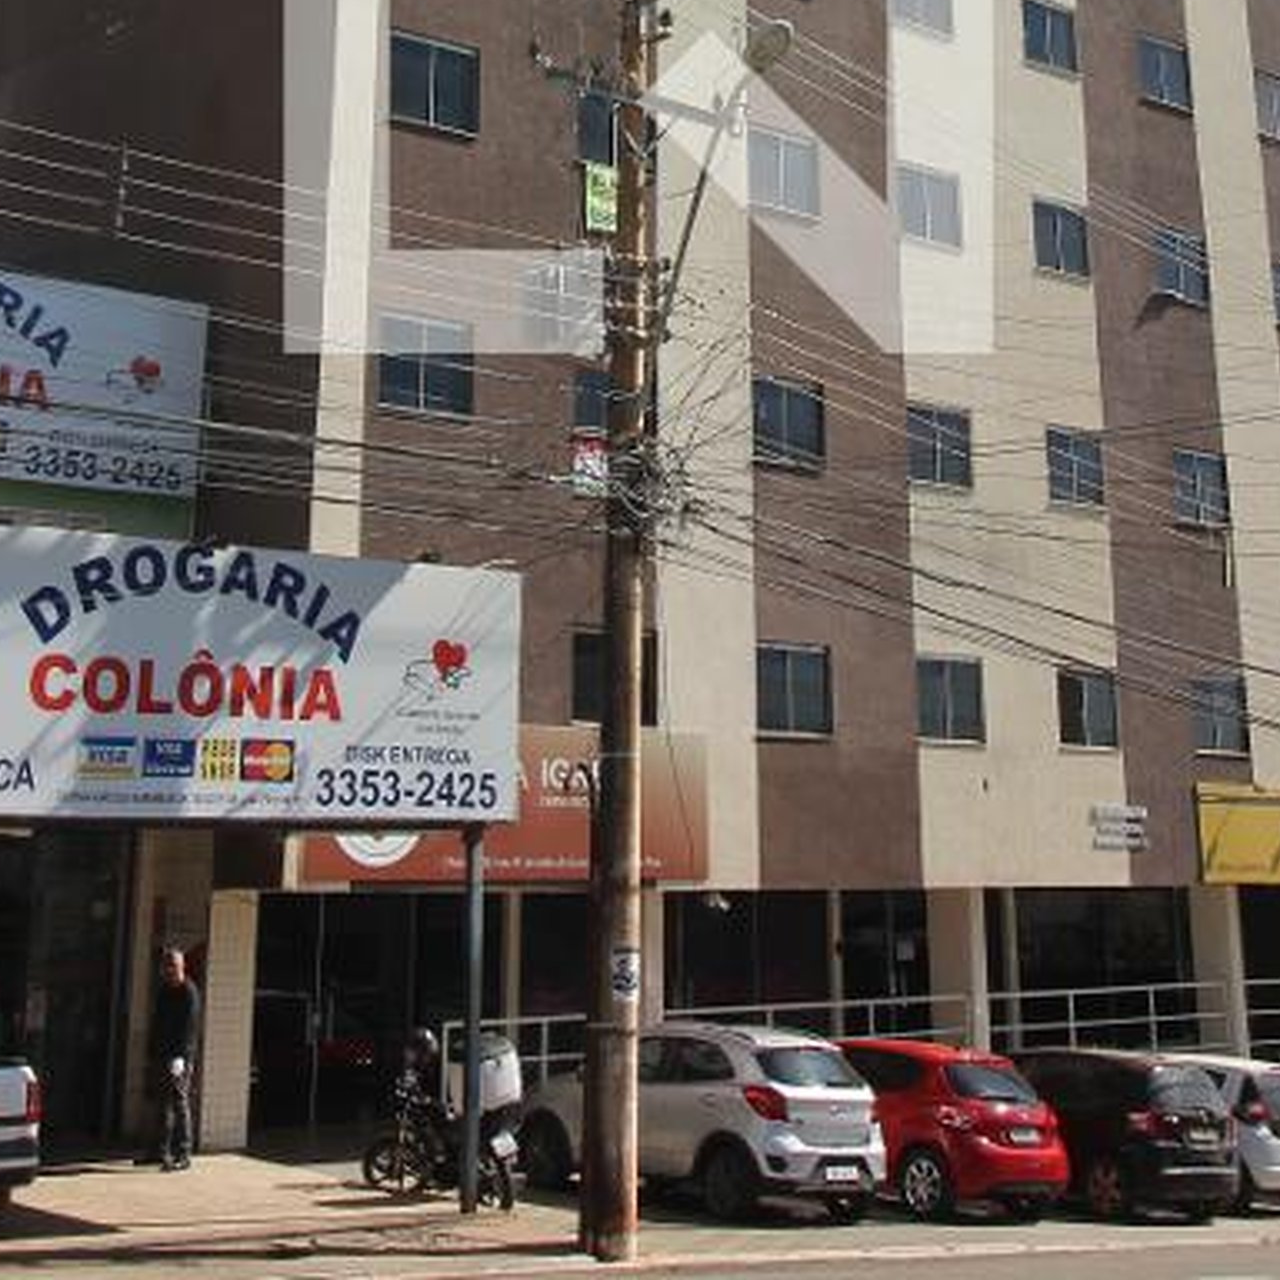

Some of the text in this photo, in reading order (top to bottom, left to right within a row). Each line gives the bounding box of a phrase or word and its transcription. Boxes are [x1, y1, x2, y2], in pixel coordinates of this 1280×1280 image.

[23, 444, 181, 491] 3353-2425
[20, 542, 364, 664] DROGARIA
[29, 650, 343, 722] COLÔNIA
[346, 745, 472, 766] DISK ENTREGA
[316, 768, 498, 810] 3353-2425
